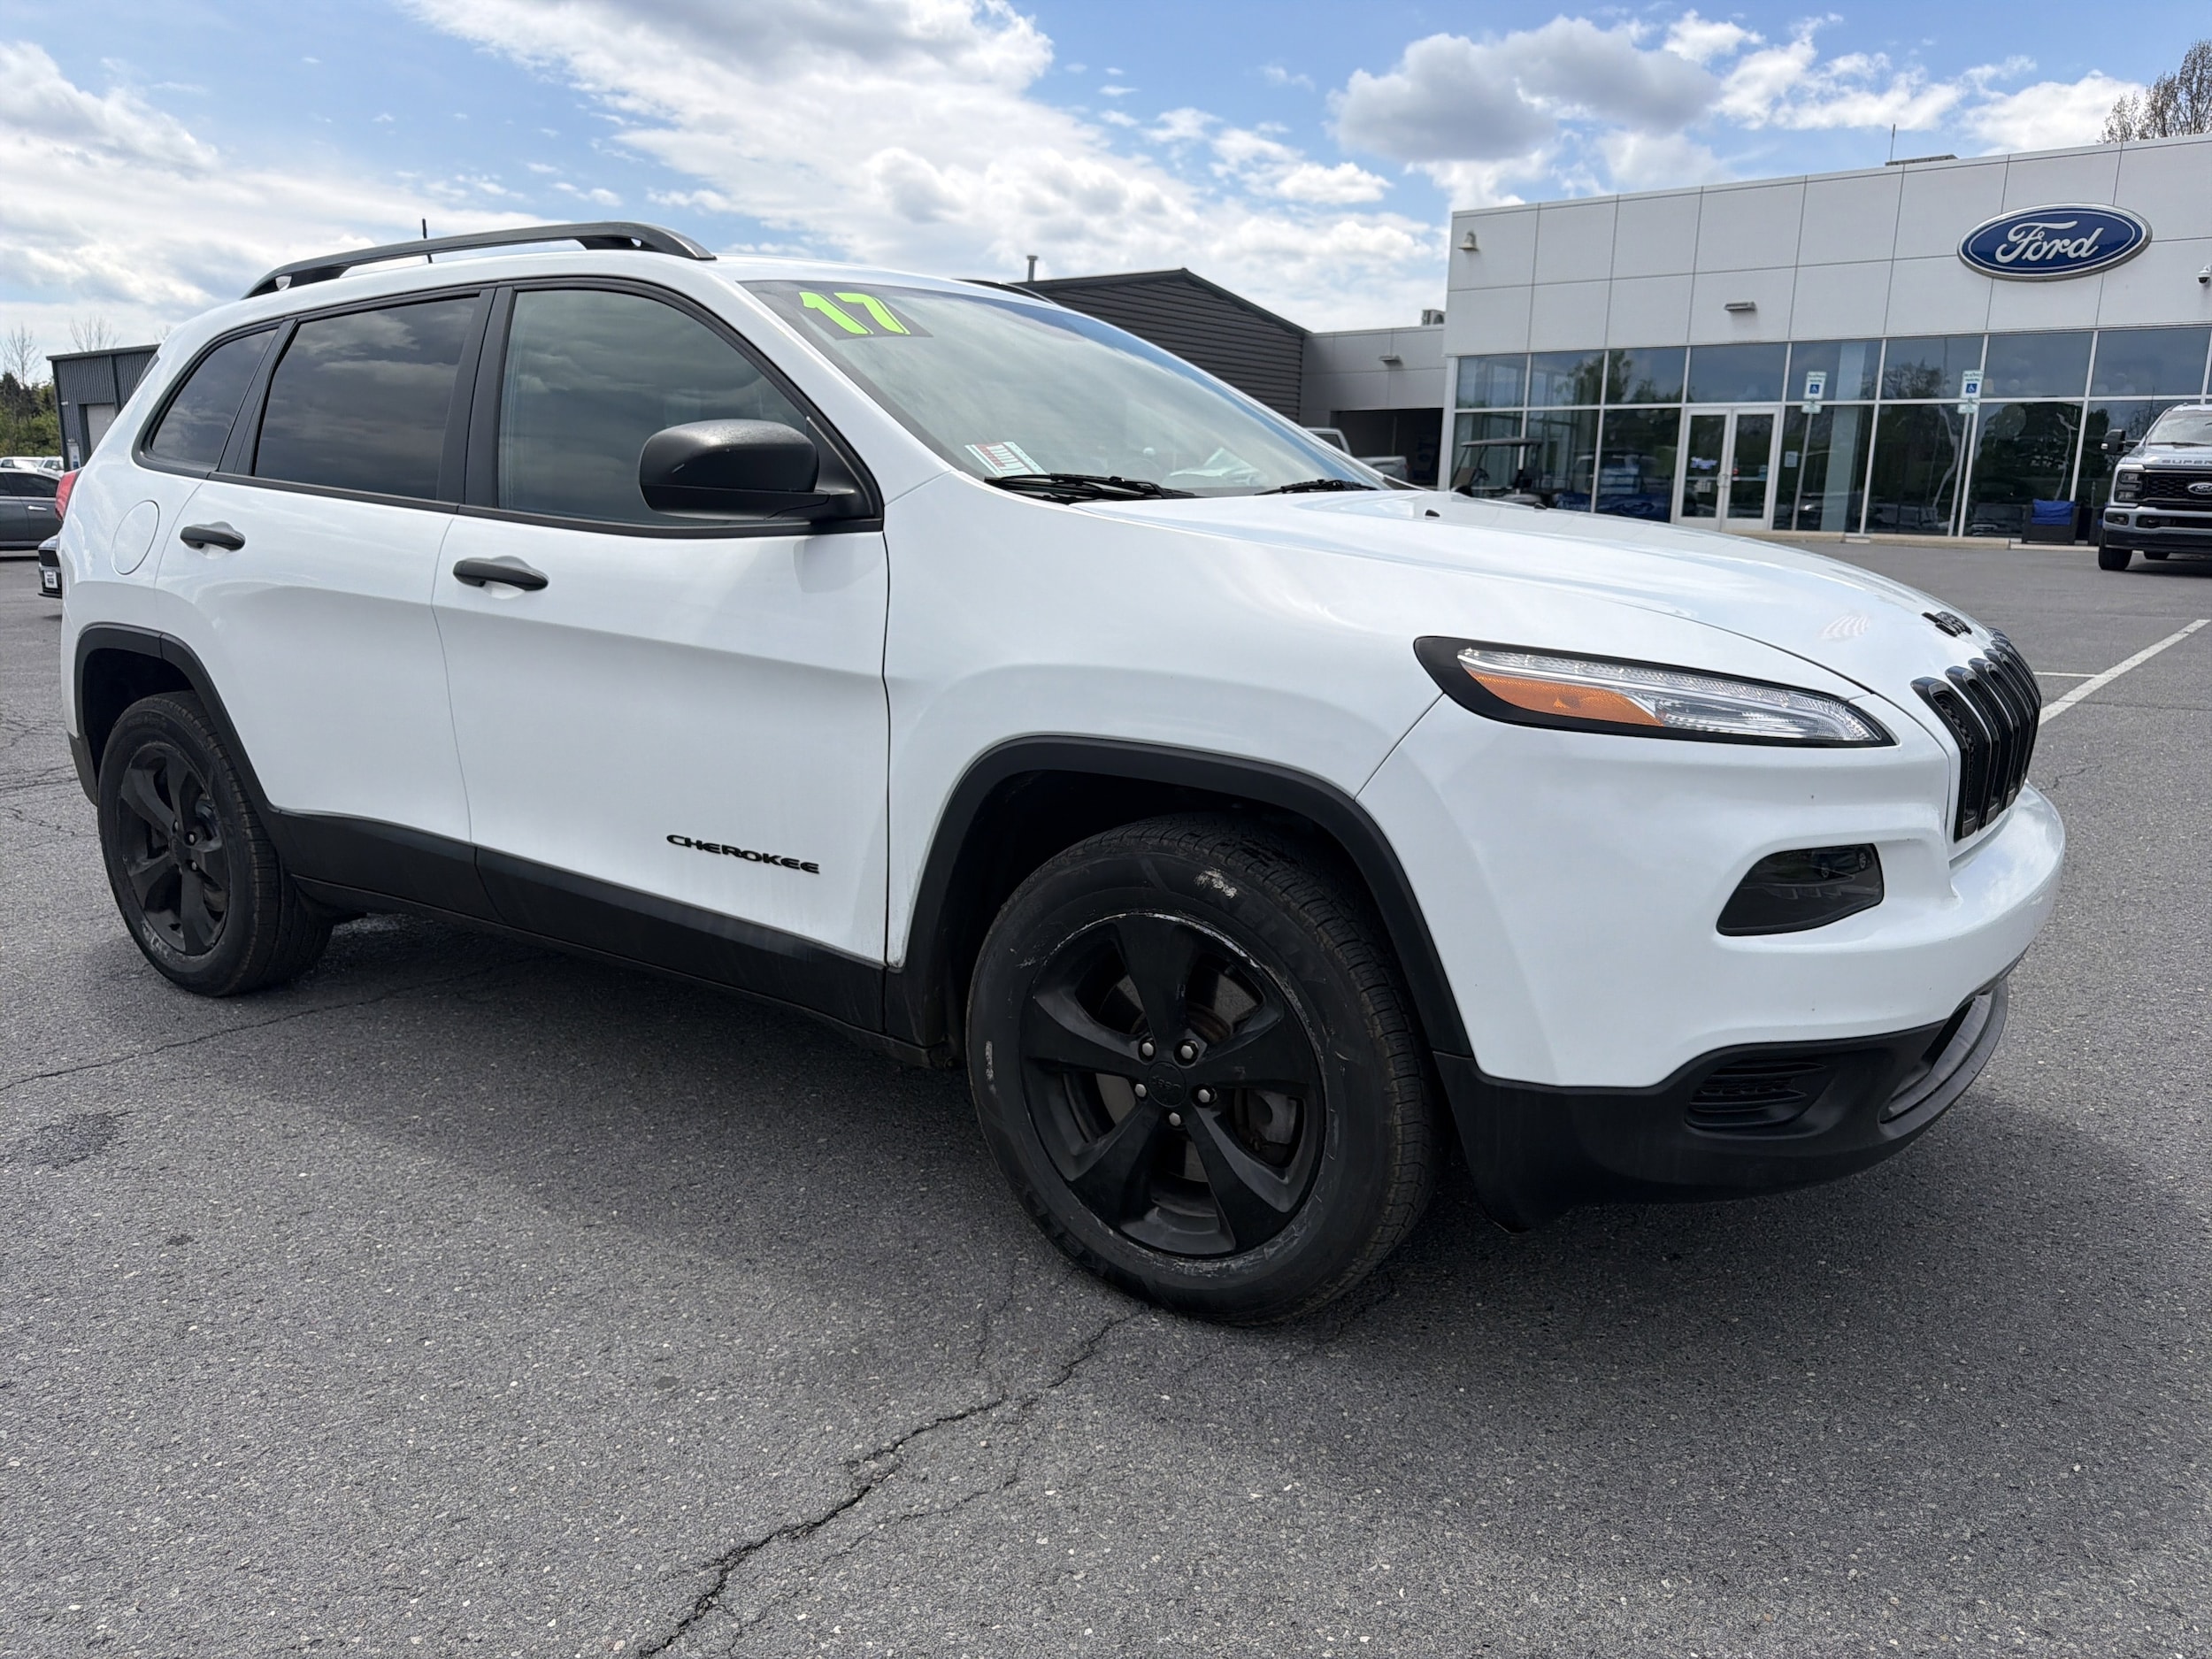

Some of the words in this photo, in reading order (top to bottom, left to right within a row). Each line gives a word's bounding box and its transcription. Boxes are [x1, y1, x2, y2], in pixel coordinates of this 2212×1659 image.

[1994, 220, 2104, 264] Ford
[798, 291, 911, 335] 17
[666, 834, 820, 875] CHEROKEE
